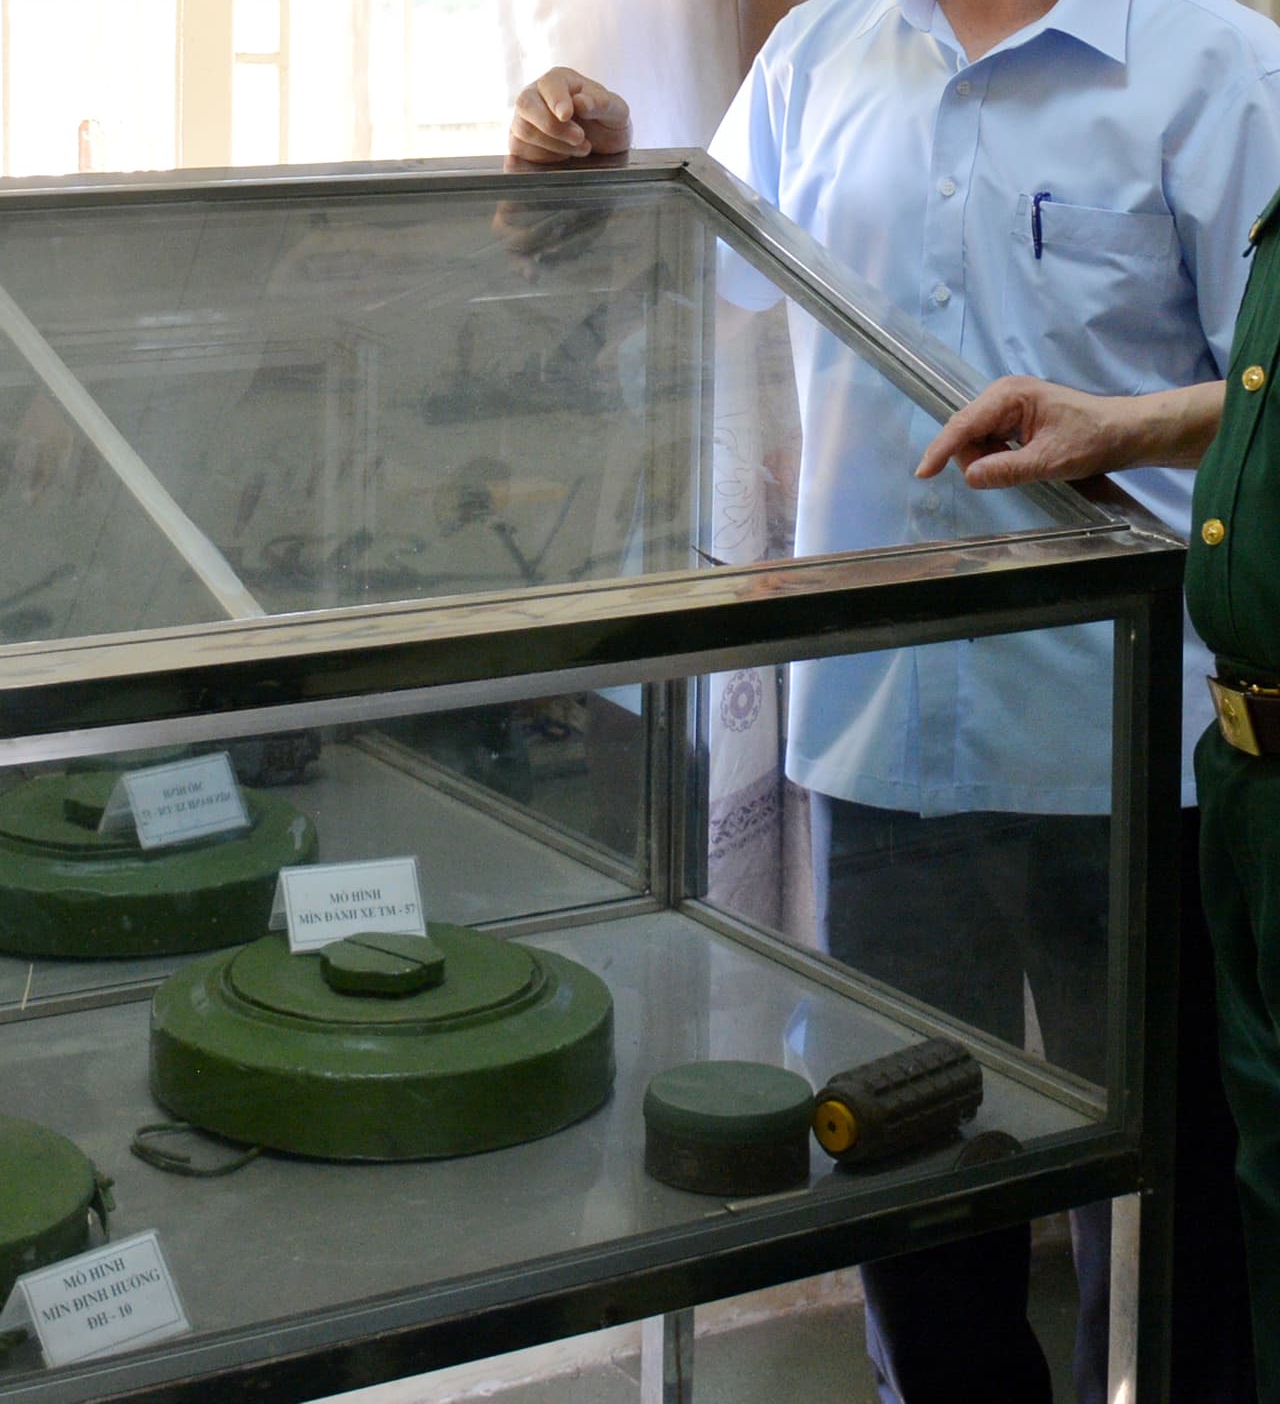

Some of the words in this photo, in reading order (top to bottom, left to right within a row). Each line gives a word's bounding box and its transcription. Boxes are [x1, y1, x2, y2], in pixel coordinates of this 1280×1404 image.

[329, 890, 349, 905] MÔ
[351, 887, 381, 903] HÌNH
[298, 910, 322, 926] MÌN
[359, 906, 377, 919] XE
[378, 904, 396, 917] TM
[404, 903, 416, 915] 57
[62, 1268, 87, 1291] MÔ
[89, 1257, 126, 1281] HÌNH
[41, 1302, 71, 1324] MÌN
[73, 1287, 109, 1314] ĐỊNH
[86, 1312, 109, 1330] ĐH
[119, 1303, 133, 1319] 10
